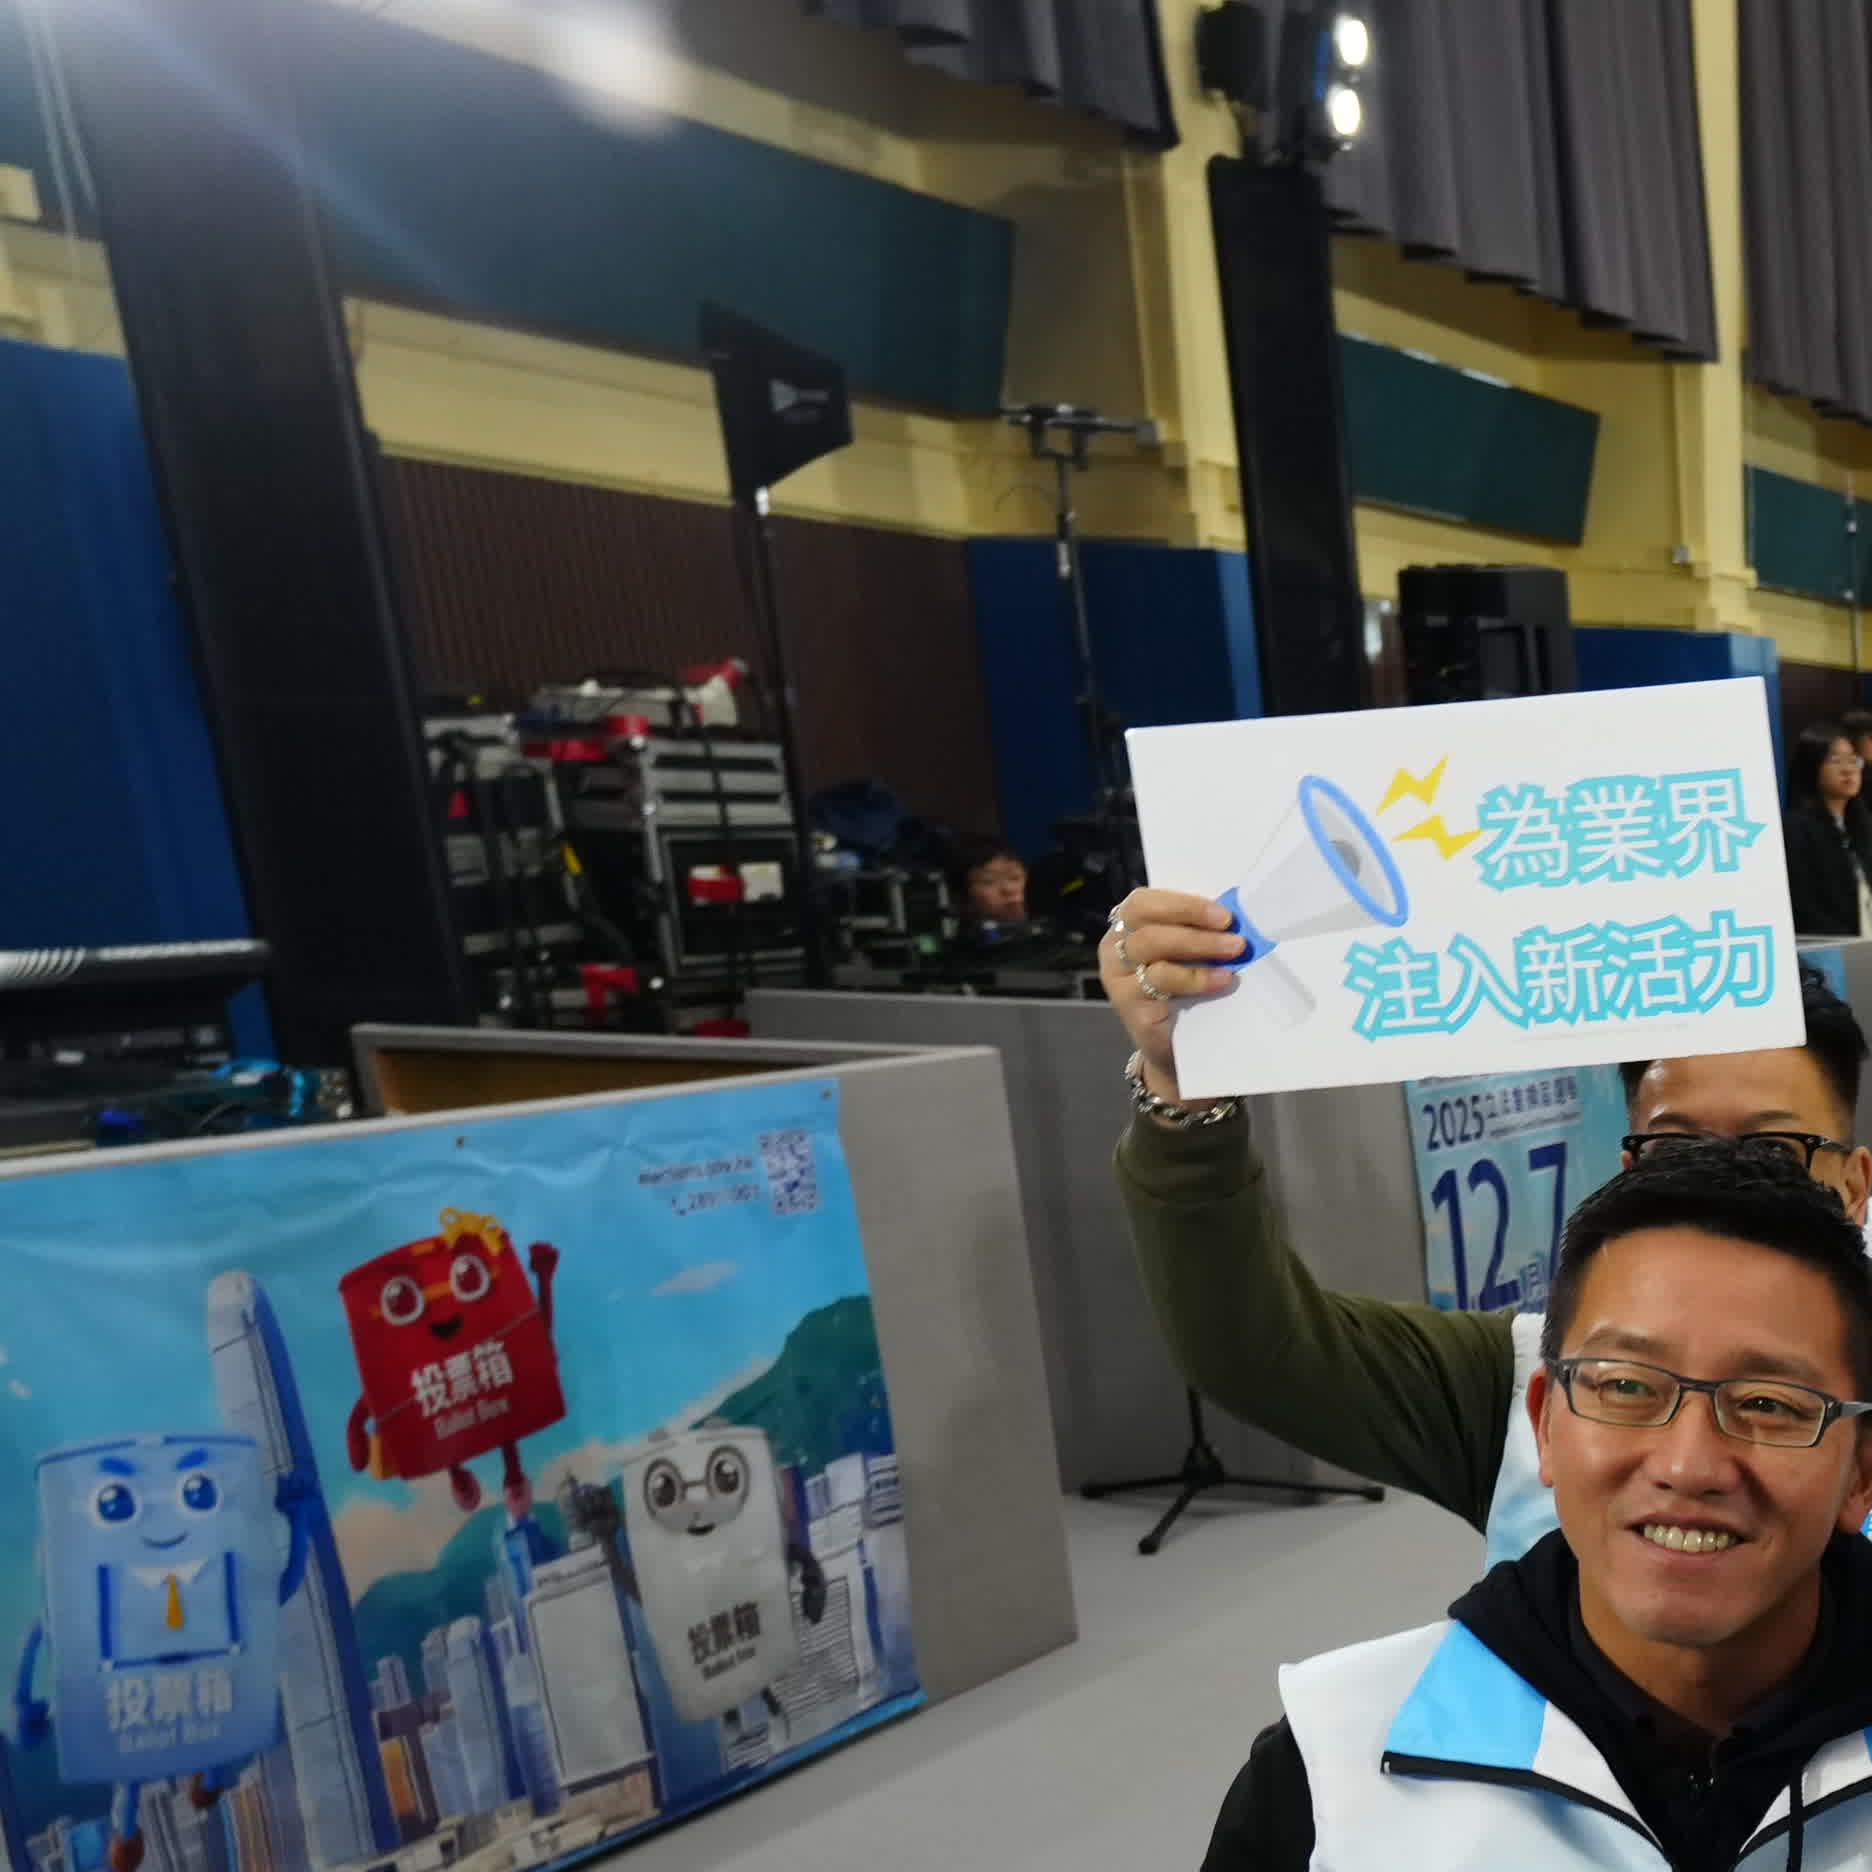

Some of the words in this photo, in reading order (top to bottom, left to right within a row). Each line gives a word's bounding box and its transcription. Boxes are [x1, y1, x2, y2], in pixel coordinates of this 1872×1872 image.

[1476, 769, 1766, 890] 為業界
[1342, 909, 1775, 1041] 注入新活力
[1422, 1096, 1484, 1151] 2025
[411, 1337, 513, 1418] 投票箱
